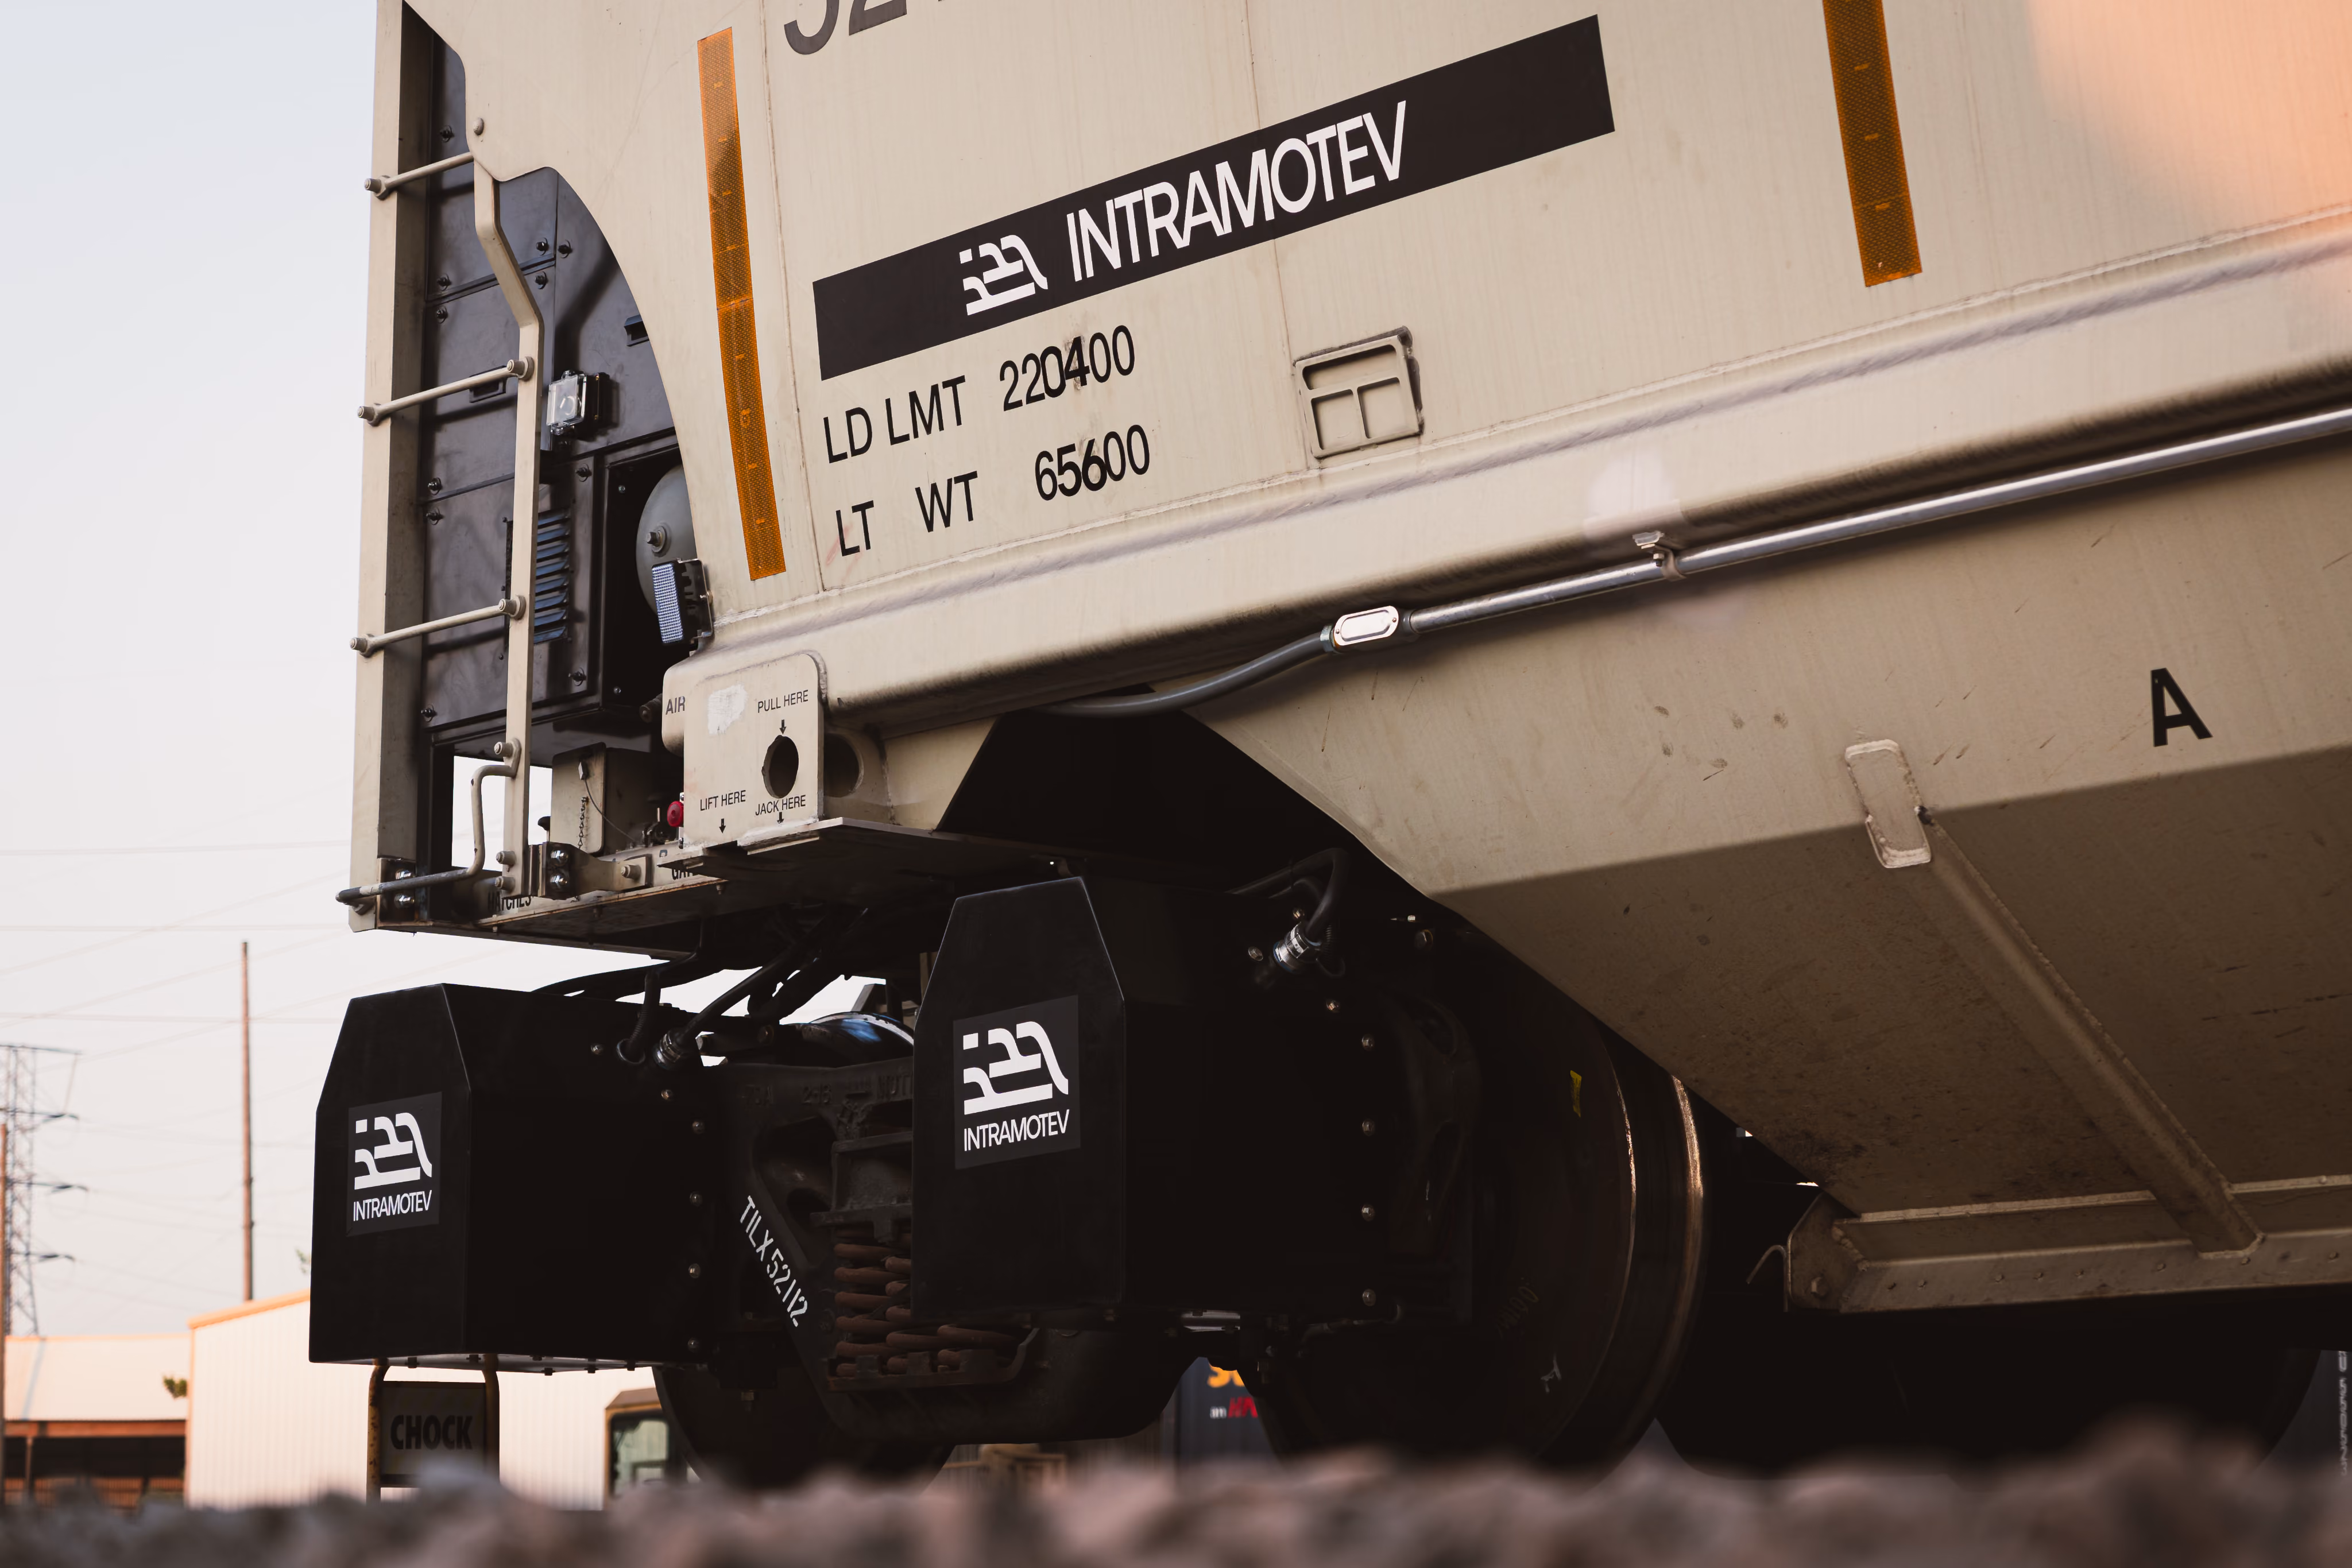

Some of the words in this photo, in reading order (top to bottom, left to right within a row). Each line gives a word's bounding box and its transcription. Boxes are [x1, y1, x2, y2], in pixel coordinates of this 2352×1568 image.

[1066, 100, 1406, 281] INTRAMOTEV
[823, 407, 873, 463] LD
[885, 375, 966, 446] LMT
[999, 325, 1135, 412] 220400
[835, 500, 875, 556] LT
[915, 471, 978, 533] WT
[1035, 424, 1150, 501] 65600
[665, 696, 686, 715] AIR
[757, 698, 782, 713] PULL
[784, 690, 809, 707] HERE
[2151, 668, 2213, 747] A
[700, 796, 719, 811] LIFT
[721, 789, 746, 807] HERE
[755, 800, 779, 816] JACK
[782, 795, 806, 811] HERE
[964, 1109, 1070, 1152] INTRAMOTEV
[353, 1190, 432, 1222] INTRAMOTEV
[740, 1195, 773, 1262] TILX
[390, 1414, 473, 1450] CHOCK
